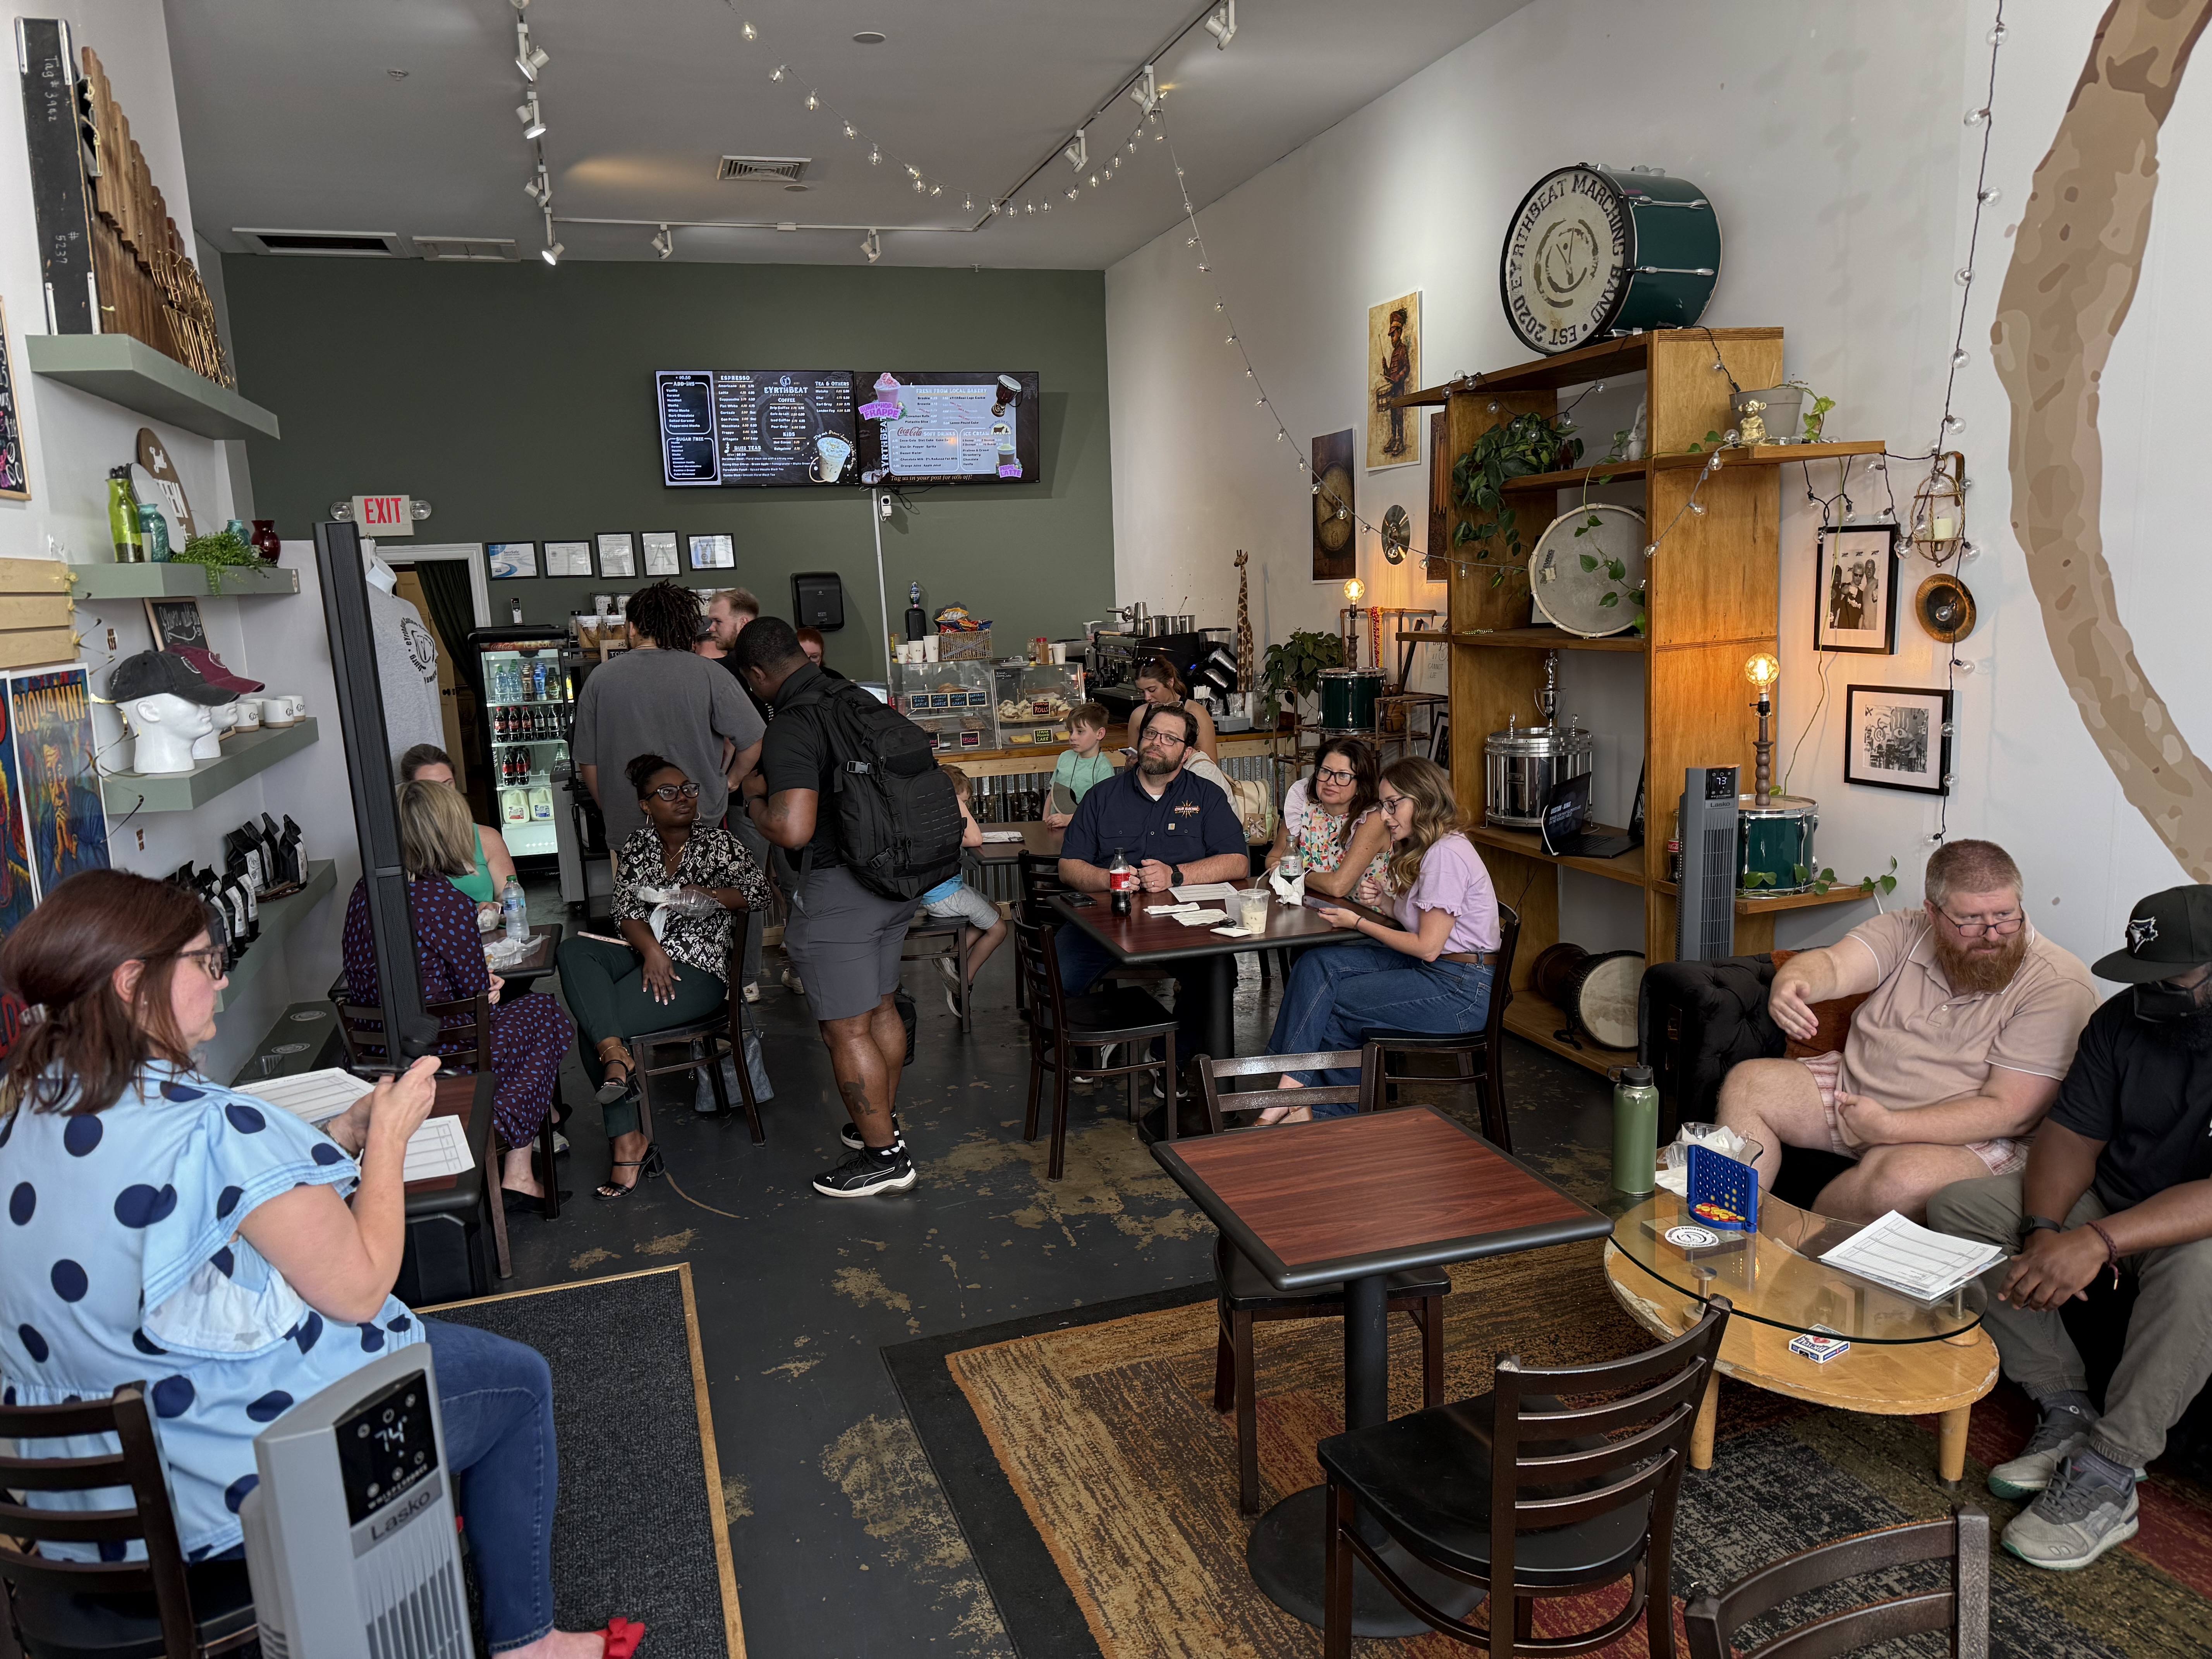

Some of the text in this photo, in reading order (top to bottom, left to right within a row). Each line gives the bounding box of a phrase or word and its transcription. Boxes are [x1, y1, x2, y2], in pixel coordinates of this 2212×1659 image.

[1571, 173, 1625, 257] MARCHING
[1590, 264, 1622, 324] BAND
[1511, 294, 1547, 342] 2020
[1549, 324, 1577, 345] EST
[859, 403, 879, 413] BUNNY
[864, 409, 899, 419] FRAPPE
[364, 497, 401, 524] EXIT
[650, 541, 675, 566] A
[1543, 548, 1553, 568] EVANS
[13, 683, 86, 735] GIOVANNI
[371, 1491, 431, 1541] Lasko
